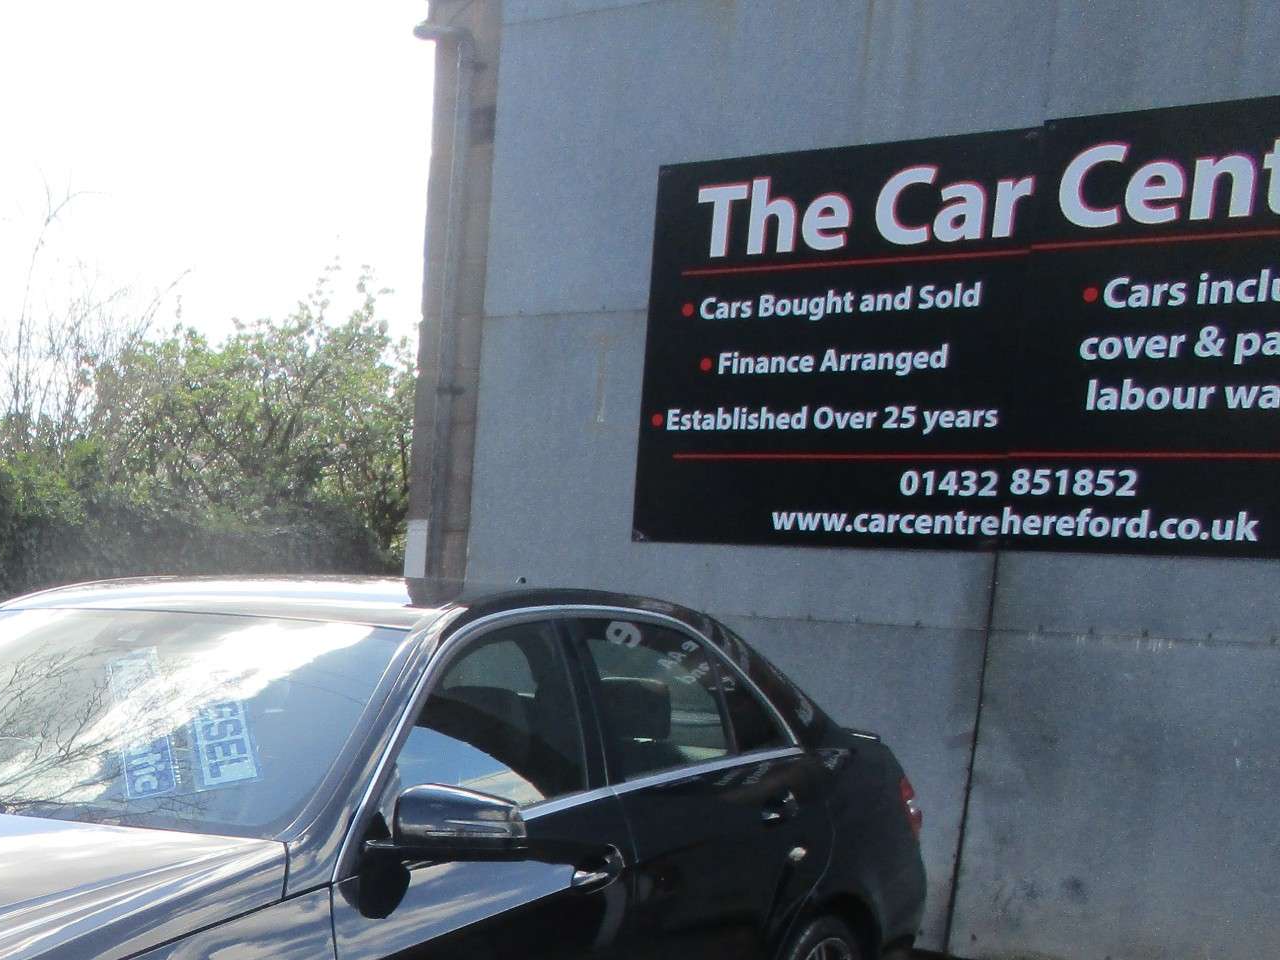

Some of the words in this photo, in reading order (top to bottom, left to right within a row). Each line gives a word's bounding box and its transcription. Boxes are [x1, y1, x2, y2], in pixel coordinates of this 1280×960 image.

[697, 176, 852, 259] The
[874, 164, 1035, 246] Car
[699, 296, 753, 320] Cars
[758, 289, 854, 321] Bought
[859, 285, 913, 313] and
[918, 281, 982, 310] Sold
[1103, 276, 1187, 309] Cars
[1079, 333, 1186, 361] cover
[1194, 325, 1225, 358] &
[718, 351, 815, 375] Finance
[819, 344, 948, 376] Arranged
[1086, 378, 1216, 411] labour
[1224, 384, 1280, 409] wa
[666, 406, 808, 431] Established
[813, 406, 878, 430] Over
[882, 406, 917, 429] 25
[922, 409, 998, 434] years
[900, 470, 998, 497] 01432
[1010, 468, 1138, 497] 851852
[772, 506, 1259, 542] www.carcentrehereford.co.uk
